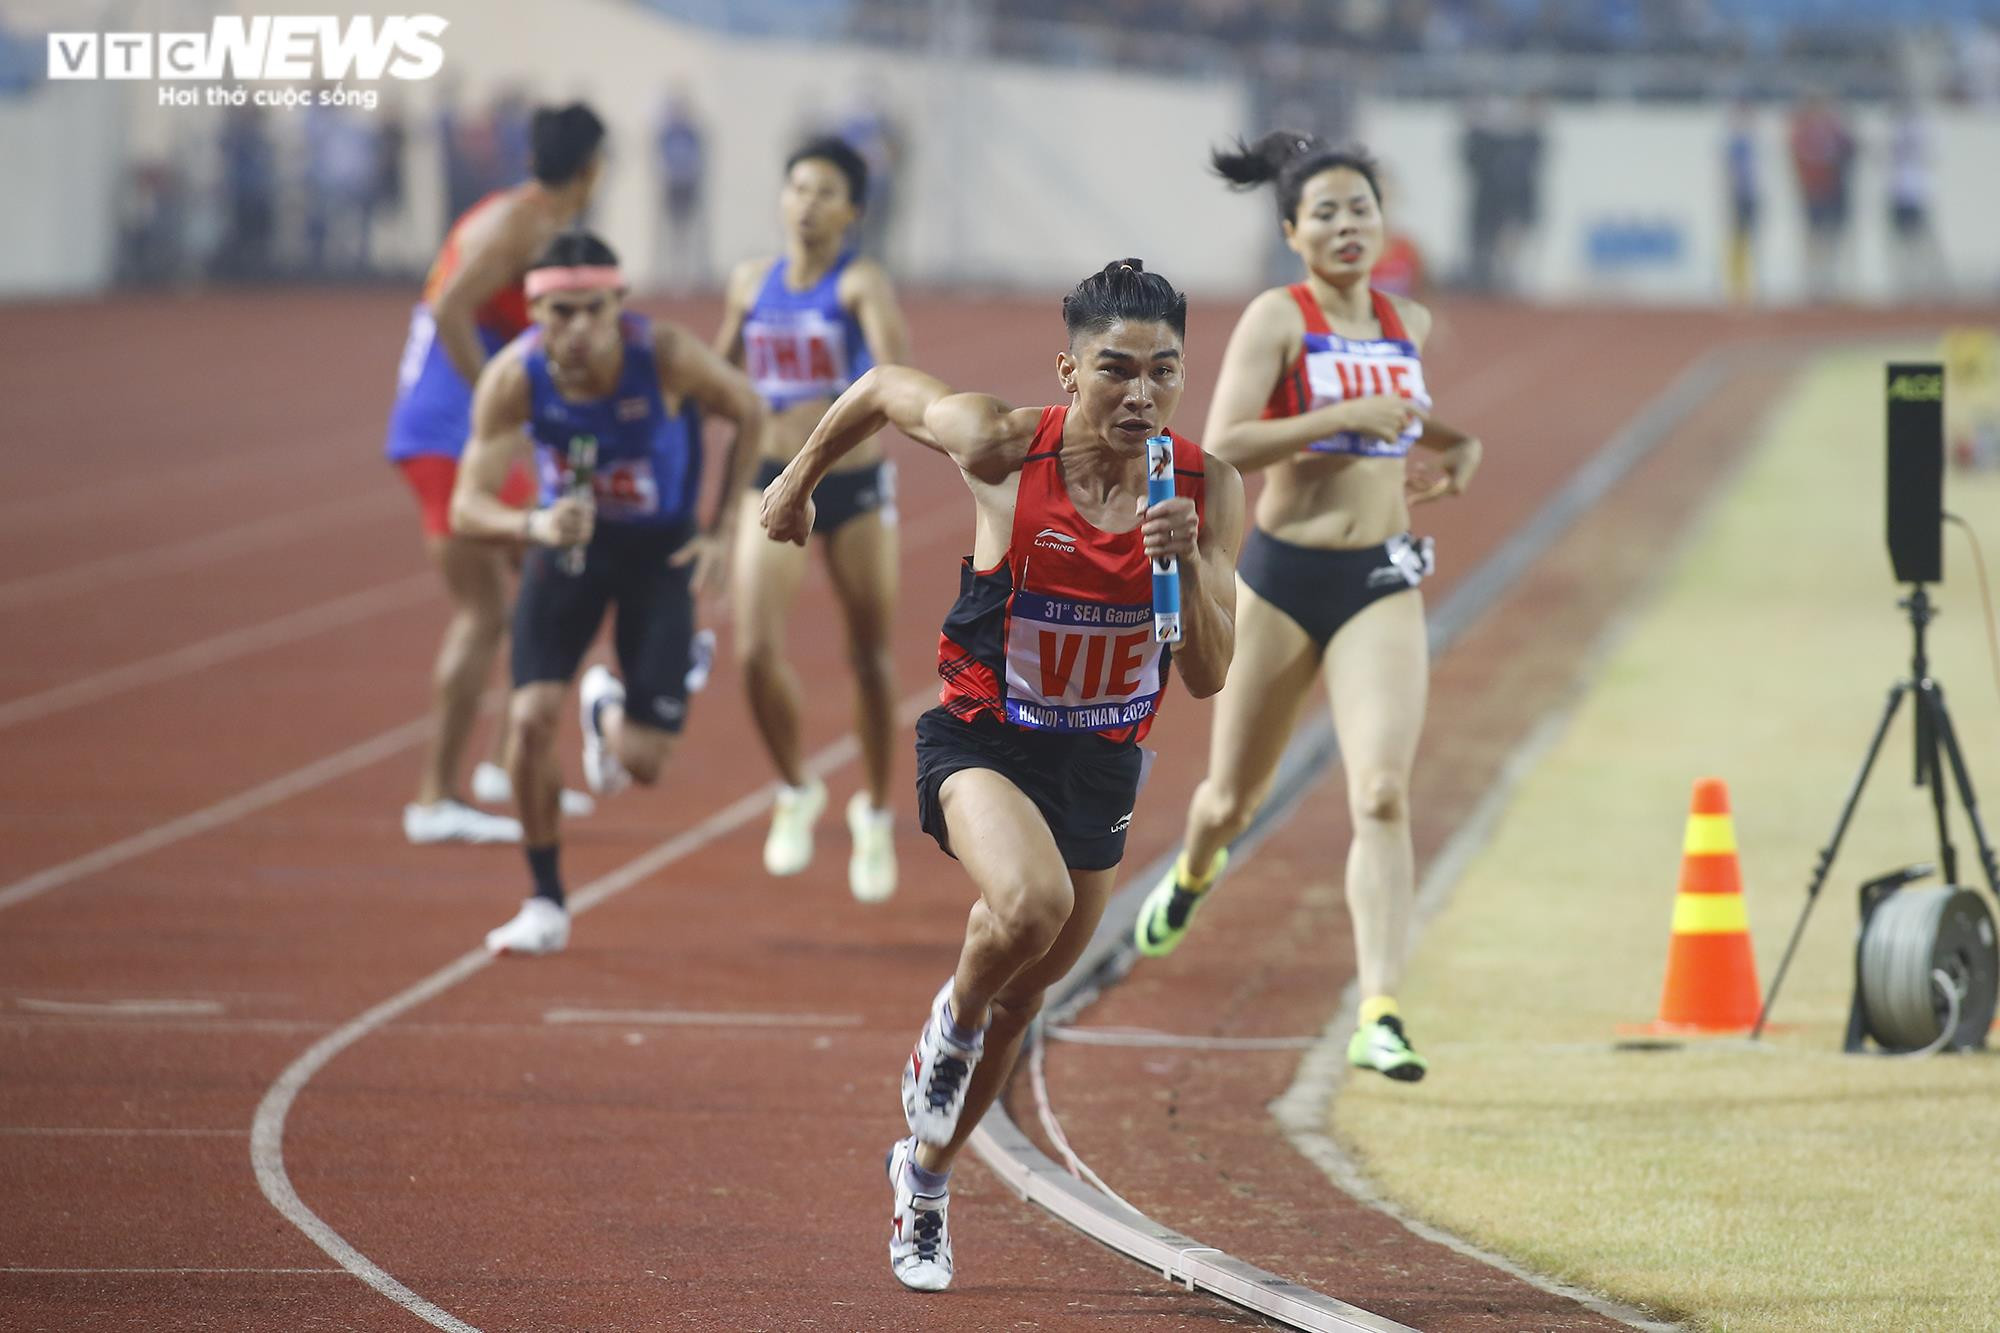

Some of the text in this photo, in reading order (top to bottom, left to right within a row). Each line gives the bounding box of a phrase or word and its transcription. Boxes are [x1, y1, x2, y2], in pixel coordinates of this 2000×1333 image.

[1034, 538, 1076, 553] LI-NING
[1073, 604, 1101, 622] SEA
[1105, 607, 1150, 624] Games
[1038, 629, 1150, 700] VIE
[1067, 707, 1119, 728] VIETNAM
[1122, 700, 1151, 723] 2022
